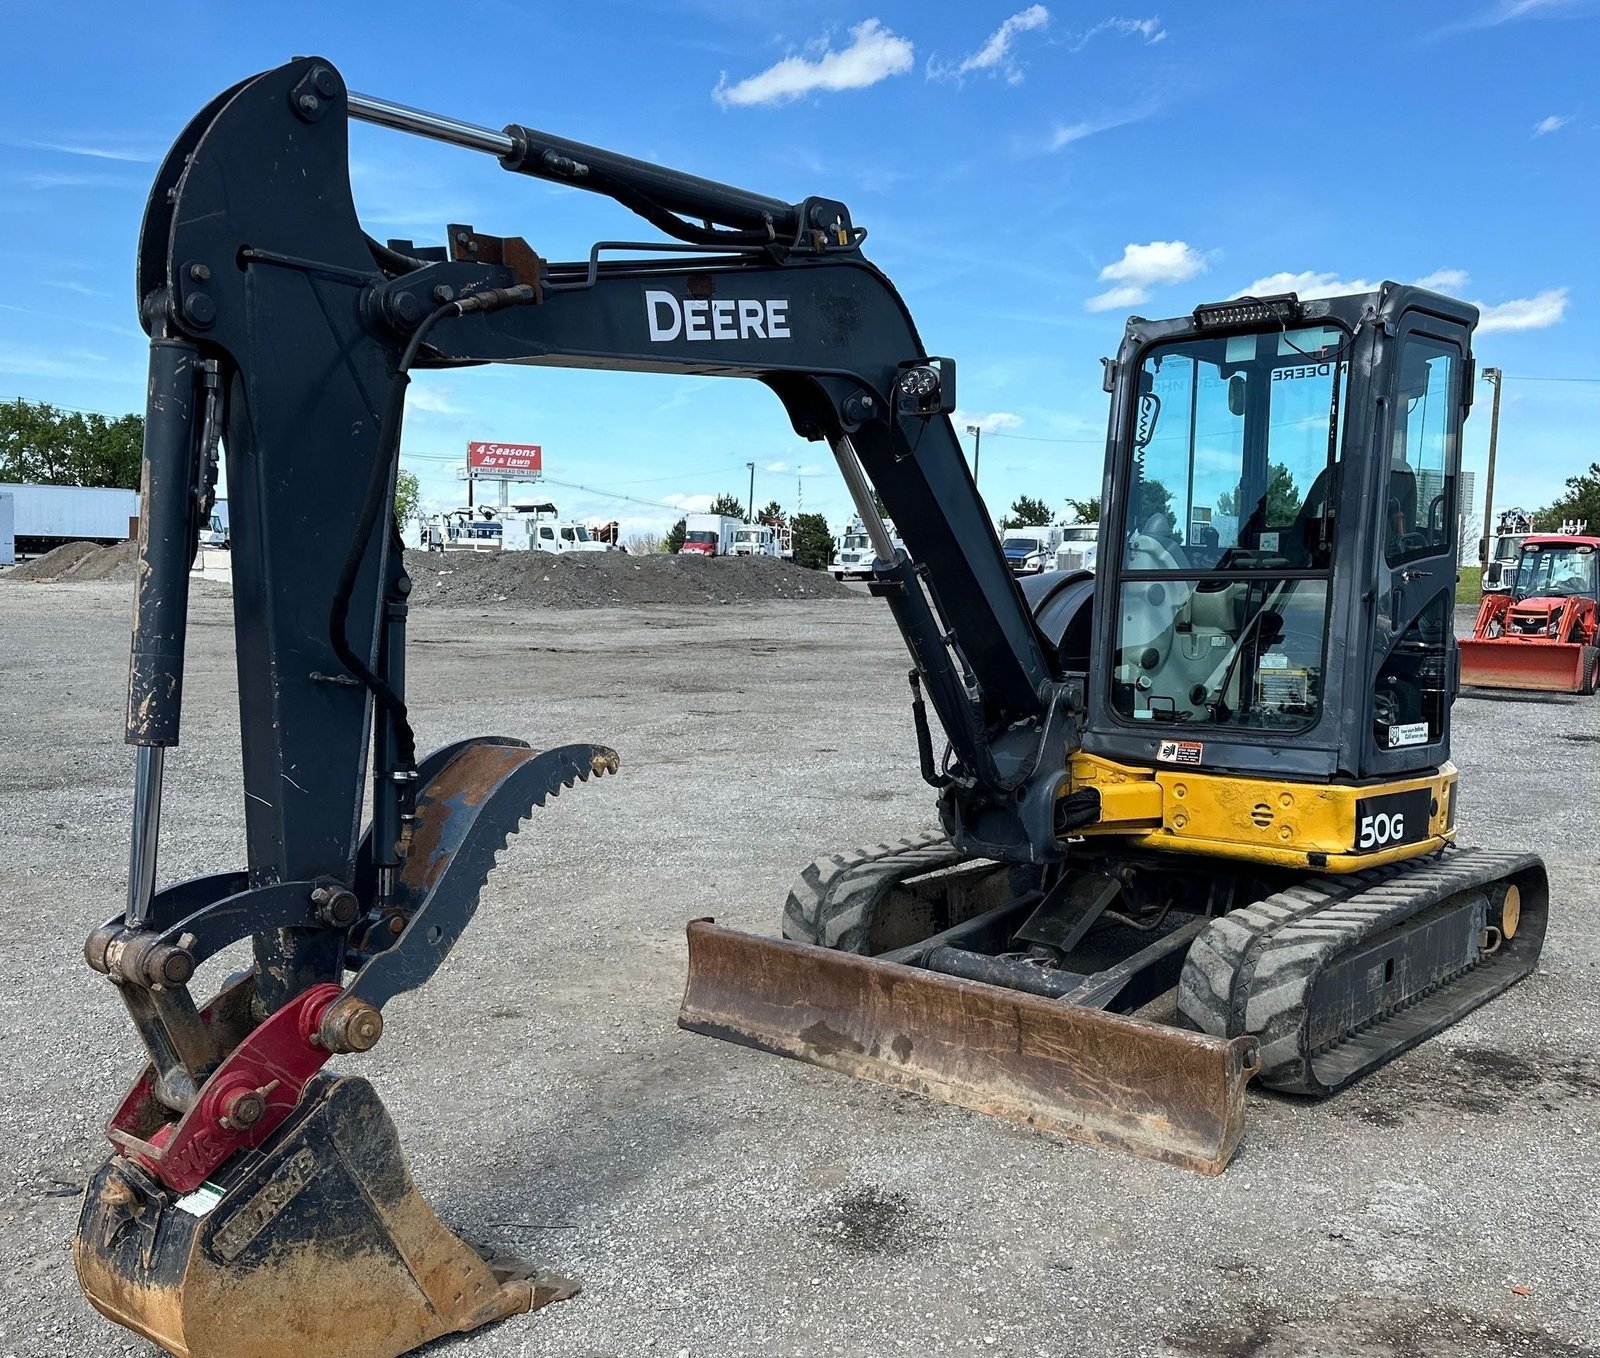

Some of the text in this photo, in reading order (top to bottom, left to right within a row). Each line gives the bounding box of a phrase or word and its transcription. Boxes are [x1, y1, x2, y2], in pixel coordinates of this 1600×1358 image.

[645, 290, 791, 342] DEERE
[476, 444, 536, 457] 4 Seasons
[481, 456, 496, 465] Ag
[507, 457, 530, 467] Lawn
[1360, 813, 1404, 848] 50G
